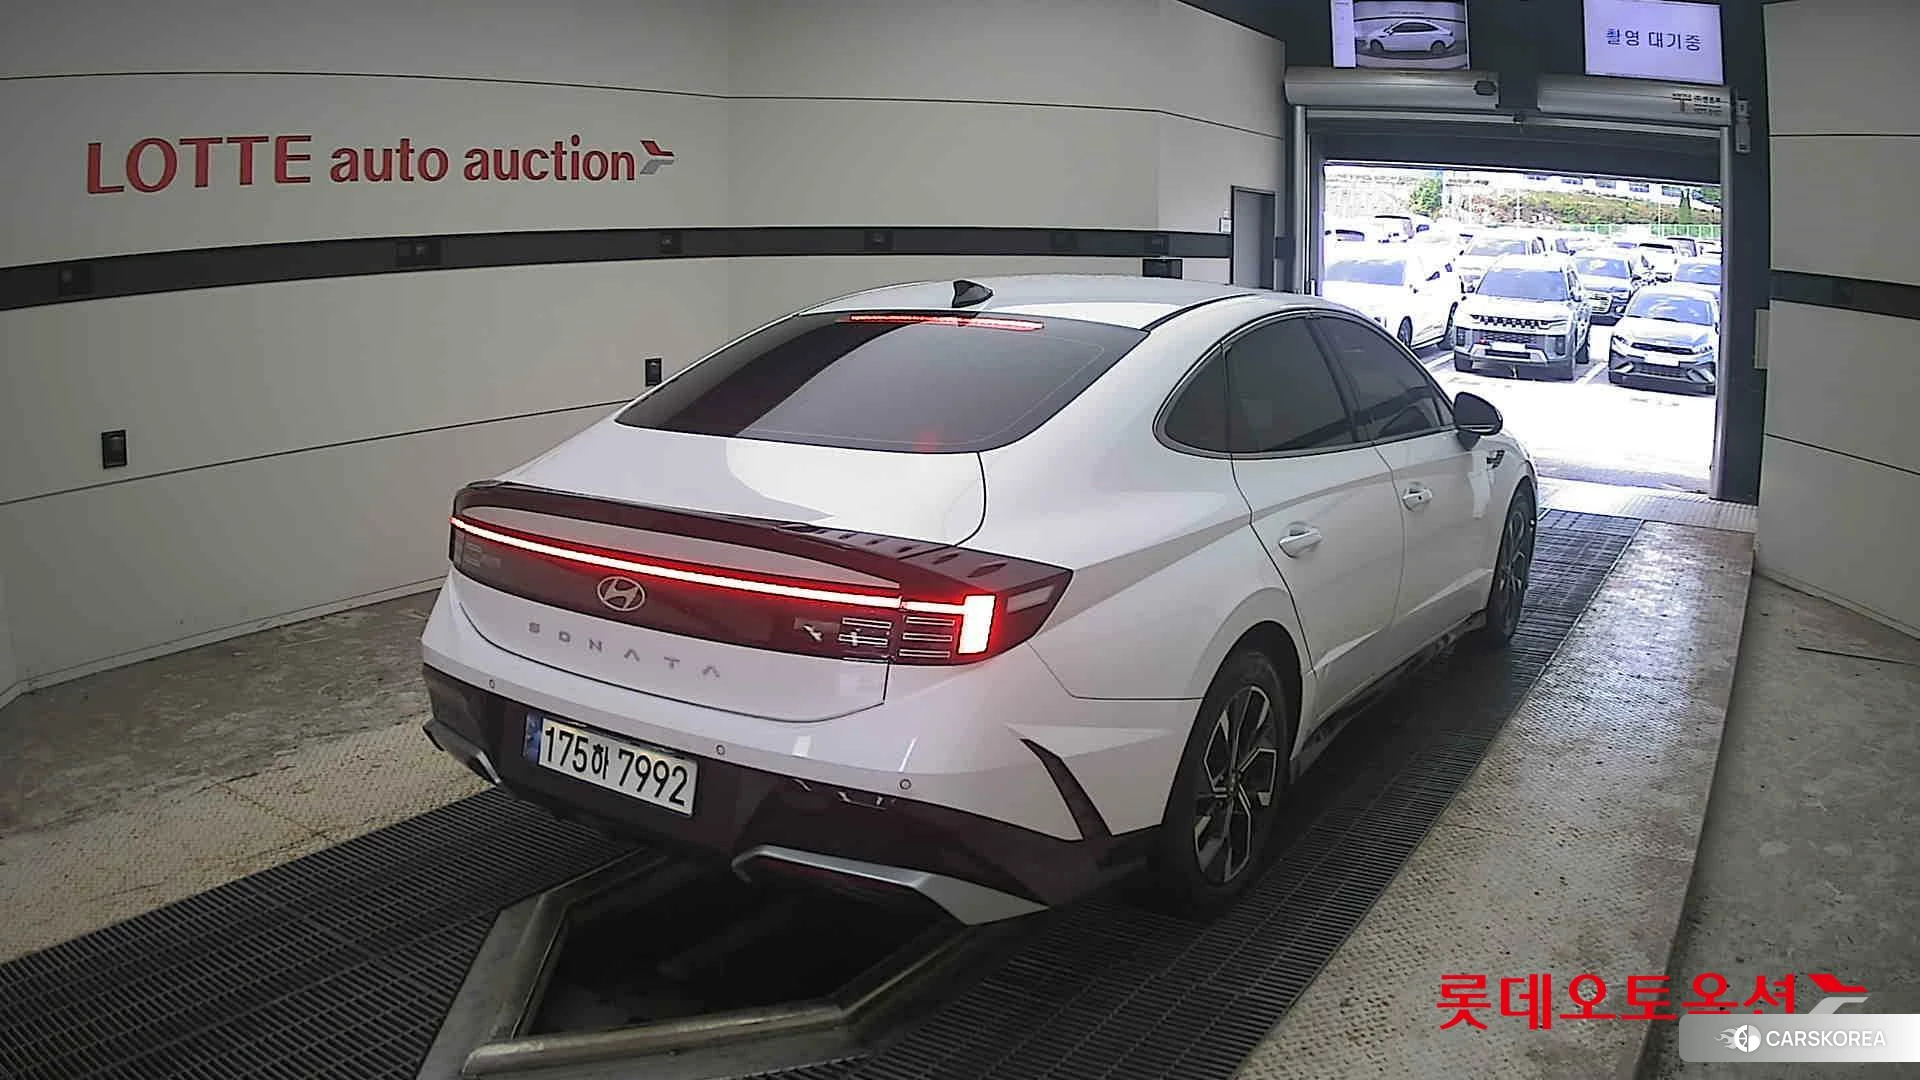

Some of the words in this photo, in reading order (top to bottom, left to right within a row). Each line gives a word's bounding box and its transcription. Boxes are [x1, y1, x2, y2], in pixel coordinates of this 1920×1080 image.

[1648, 31, 1702, 52] 대기중
[86, 134, 312, 194] LOTTE
[329, 137, 449, 184] auto
[463, 133, 635, 182] auction
[528, 621, 721, 679] SONATA
[544, 726, 610, 781] 175하
[617, 747, 689, 807] 7992
